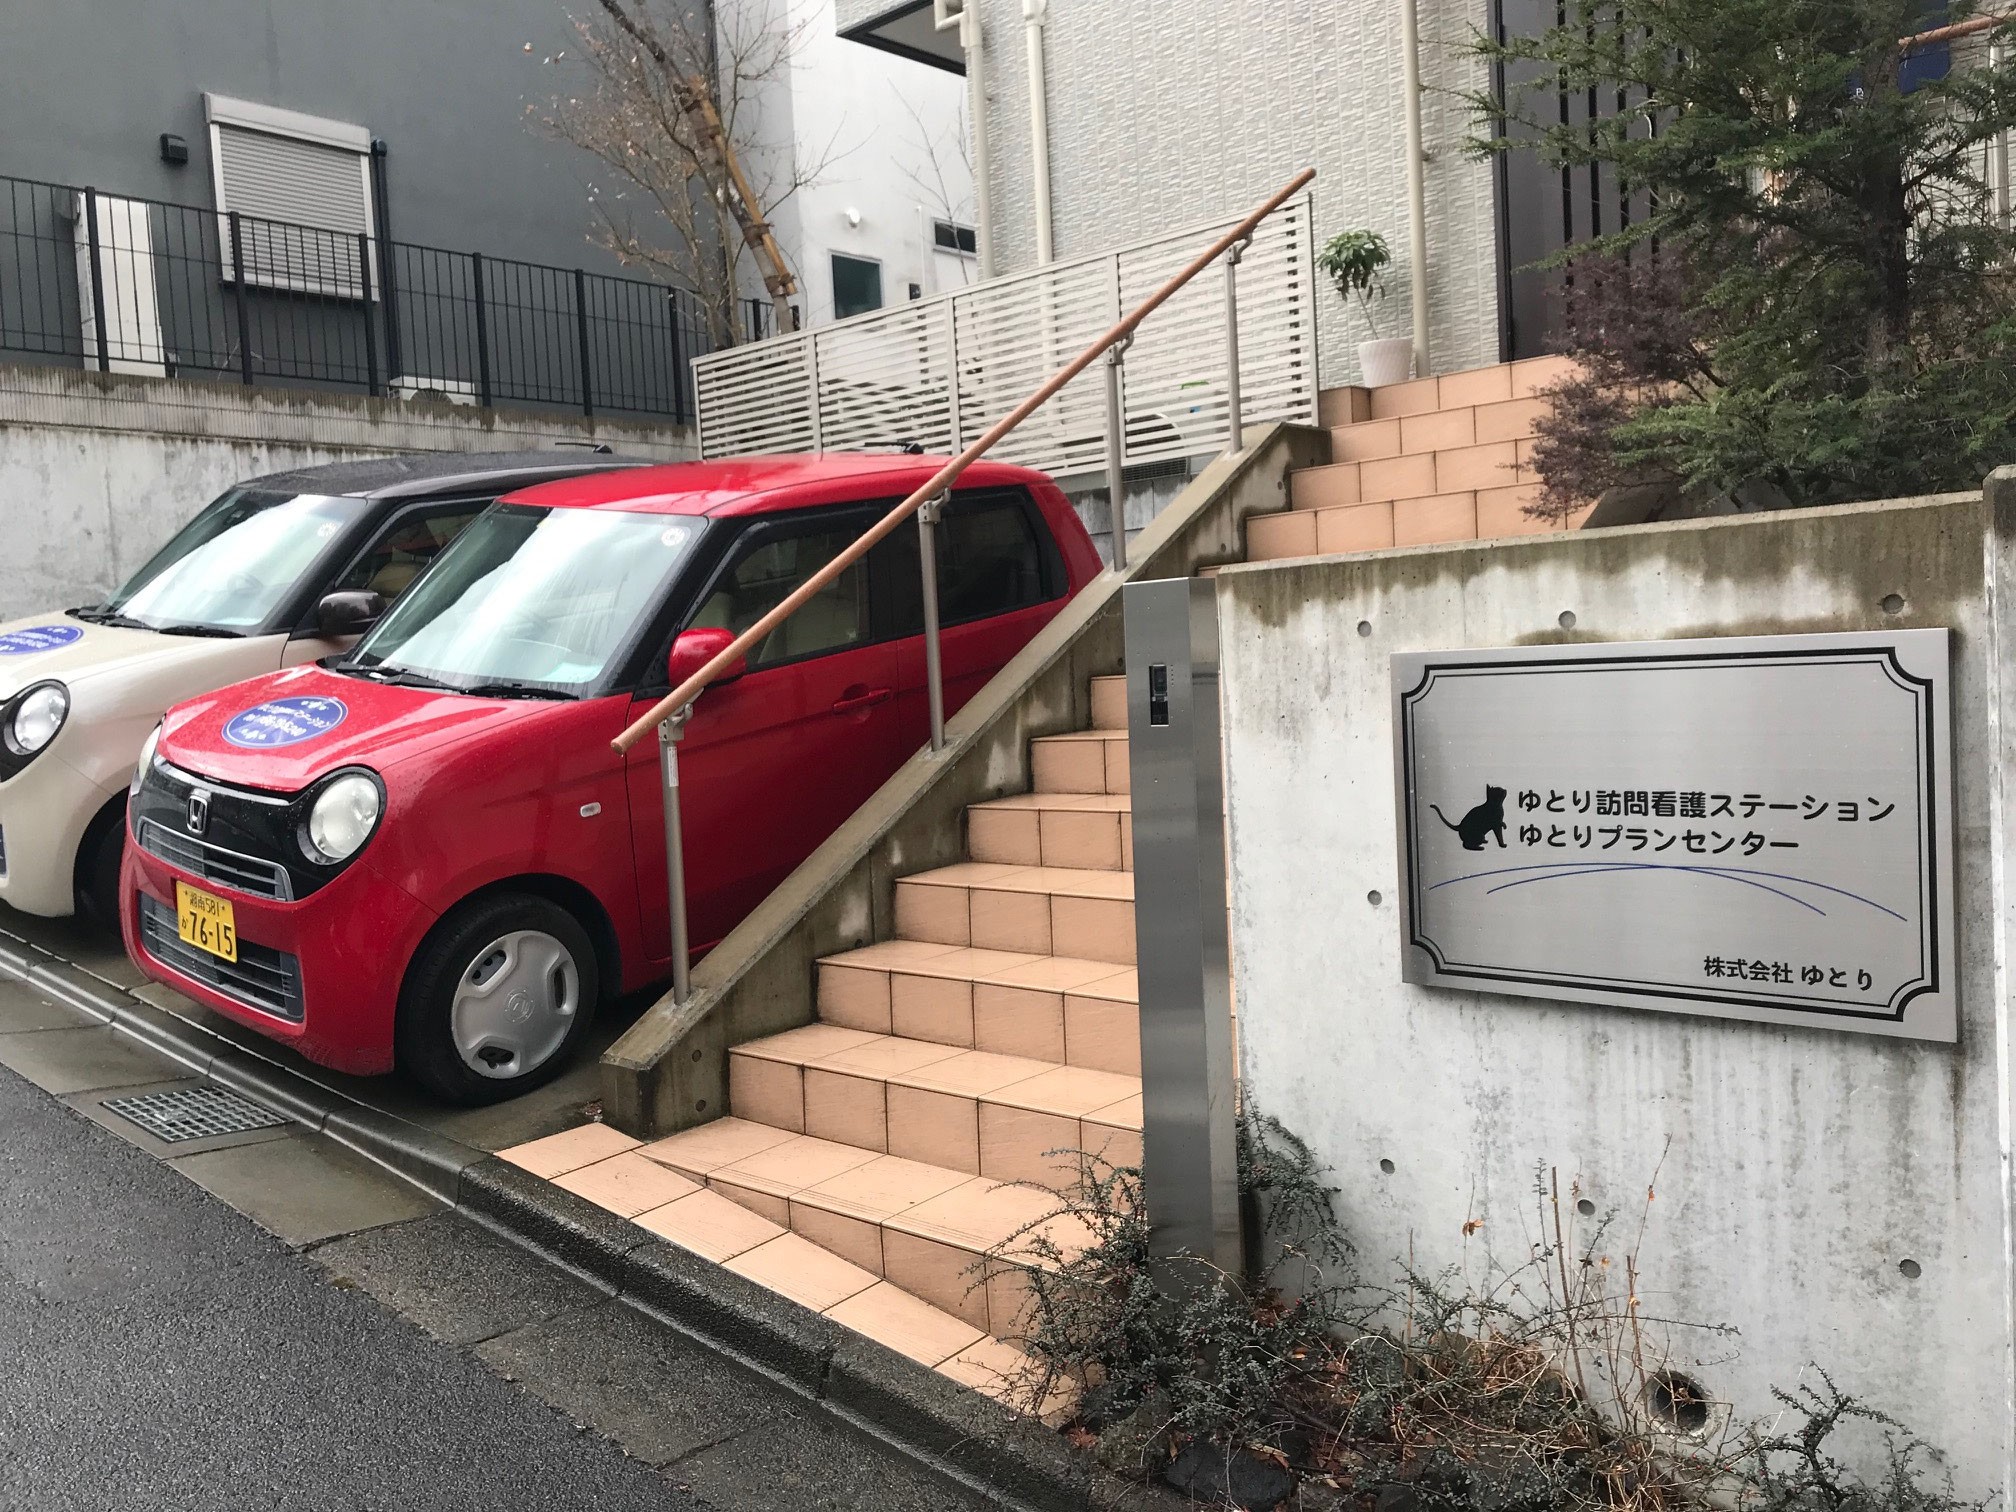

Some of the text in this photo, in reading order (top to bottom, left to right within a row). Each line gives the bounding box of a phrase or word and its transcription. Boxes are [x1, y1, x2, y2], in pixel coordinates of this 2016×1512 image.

[1518, 789, 1896, 823] ゆとり訪問看護ステーション
[1519, 825, 1800, 857] ゆとりプランセンター
[189, 910, 233, 956] 76-15
[1703, 955, 1874, 992] 株式会社 ゆとり
